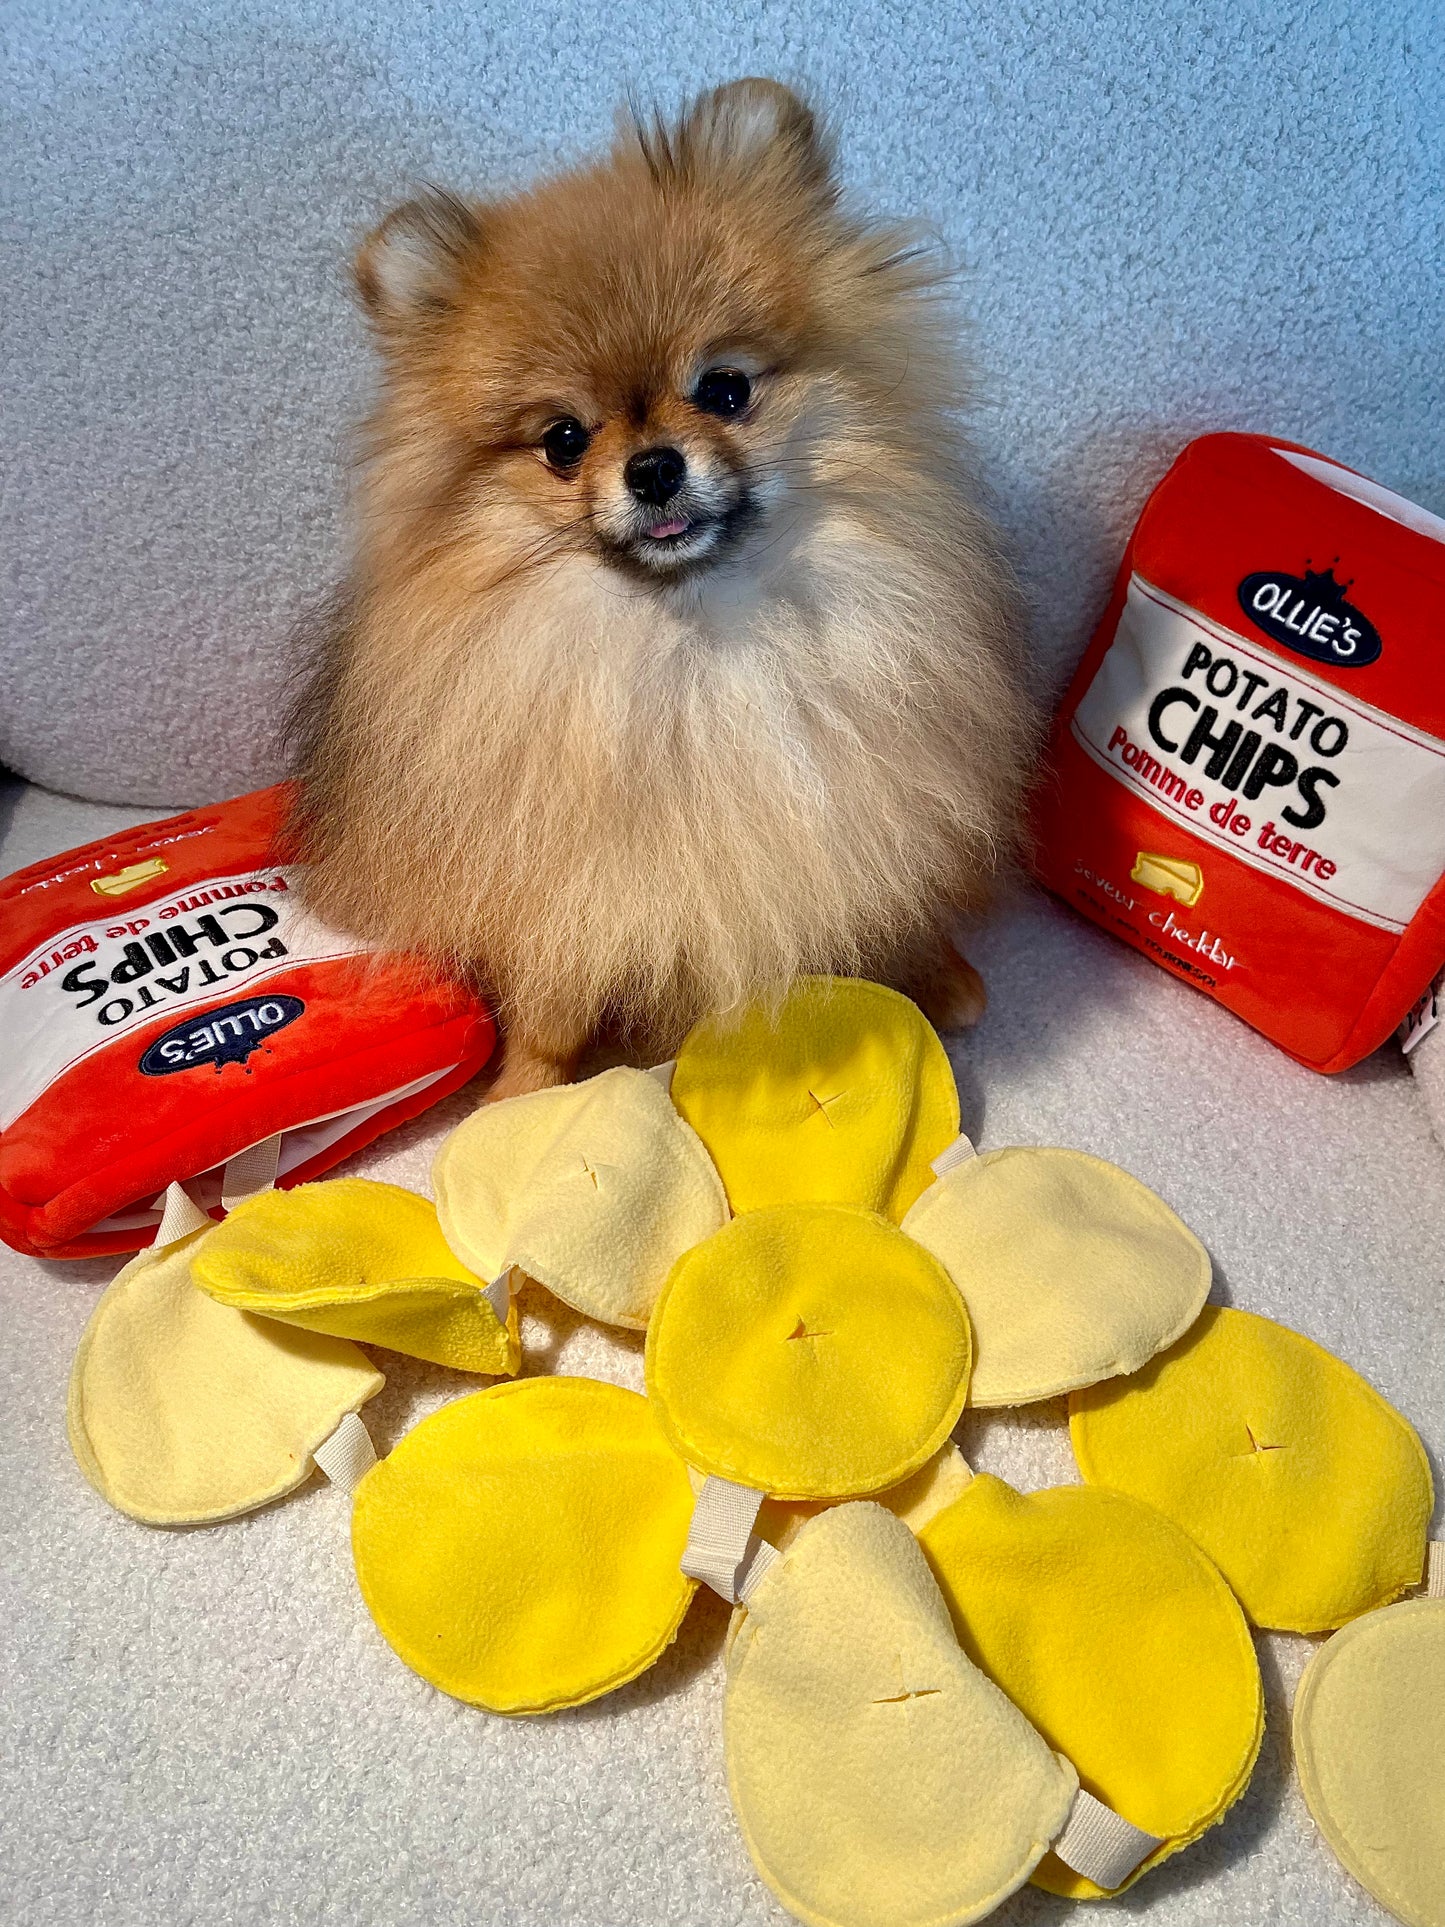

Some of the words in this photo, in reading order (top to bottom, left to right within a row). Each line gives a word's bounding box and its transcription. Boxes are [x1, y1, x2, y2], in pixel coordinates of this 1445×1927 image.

[1252, 582, 1362, 658] OLLIE'S
[1182, 641, 1349, 758] POTATO
[1148, 687, 1341, 829] CHIPS
[1107, 724, 1205, 810] Pomme
[1209, 797, 1252, 836] de
[1257, 820, 1337, 881] terre
[22, 933, 100, 991] terre
[62, 903, 280, 1009] CHIPS
[106, 916, 151, 938] de
[1148, 911, 1241, 970] cheddar
[98, 937, 289, 1026] POTATO
[159, 1001, 286, 1065] OLLIE'S
